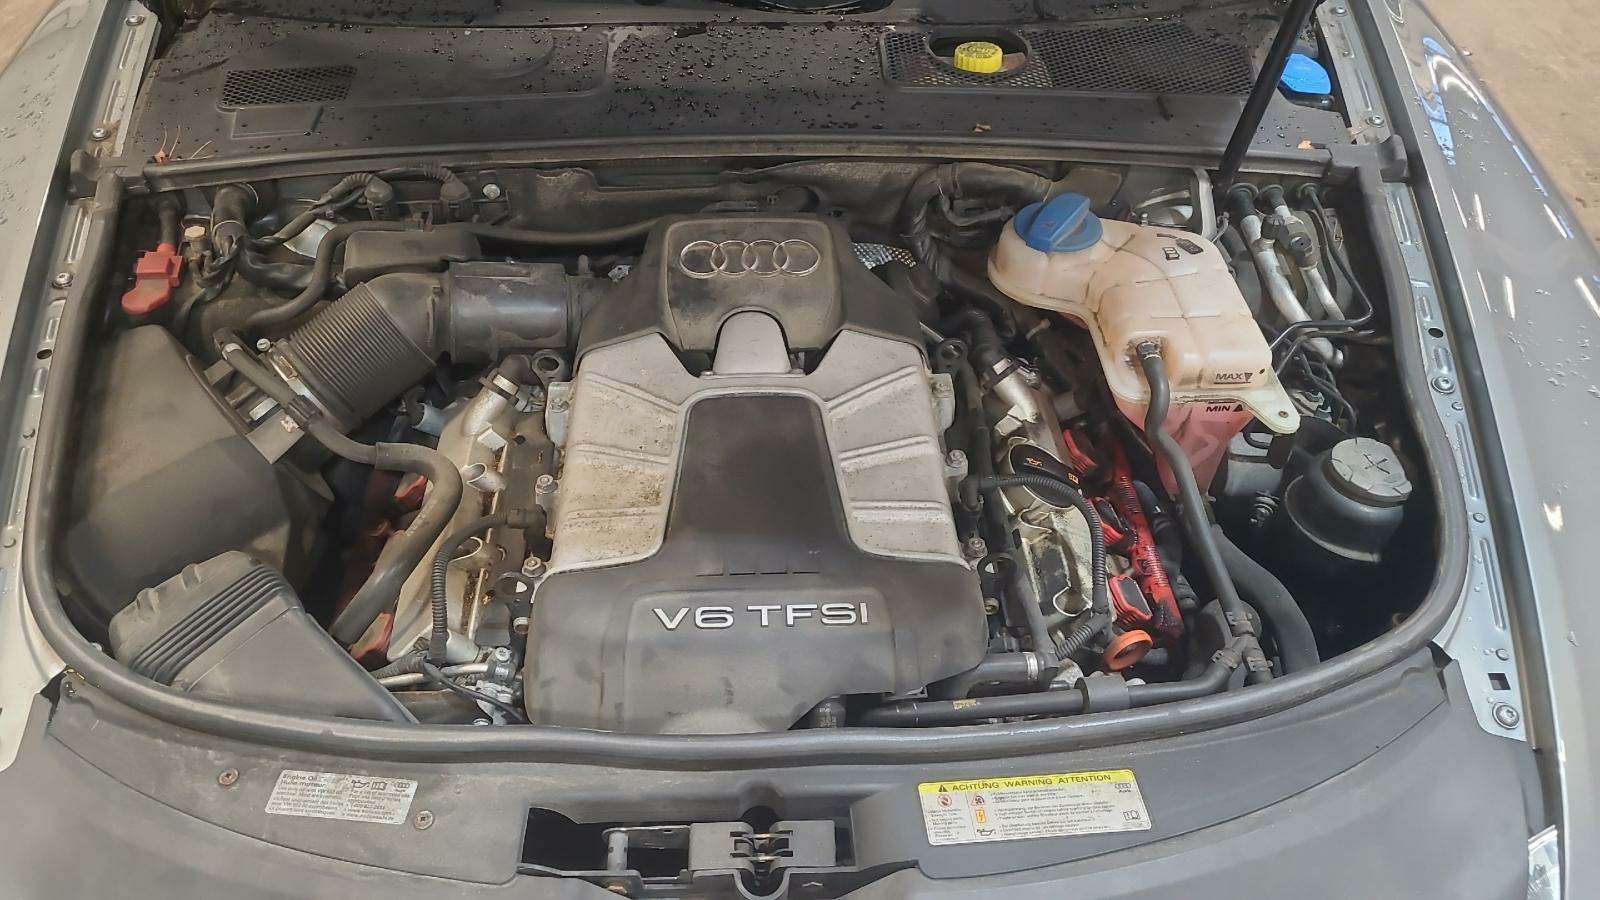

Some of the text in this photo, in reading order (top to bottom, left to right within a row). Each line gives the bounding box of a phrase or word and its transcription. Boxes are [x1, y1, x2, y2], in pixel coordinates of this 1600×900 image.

[1215, 372, 1243, 380] MAX
[1205, 405, 1231, 413] MIN
[652, 602, 869, 632] V6 TFSI
[952, 774, 1112, 791] ACHTUNG WARNING ATTENTION
